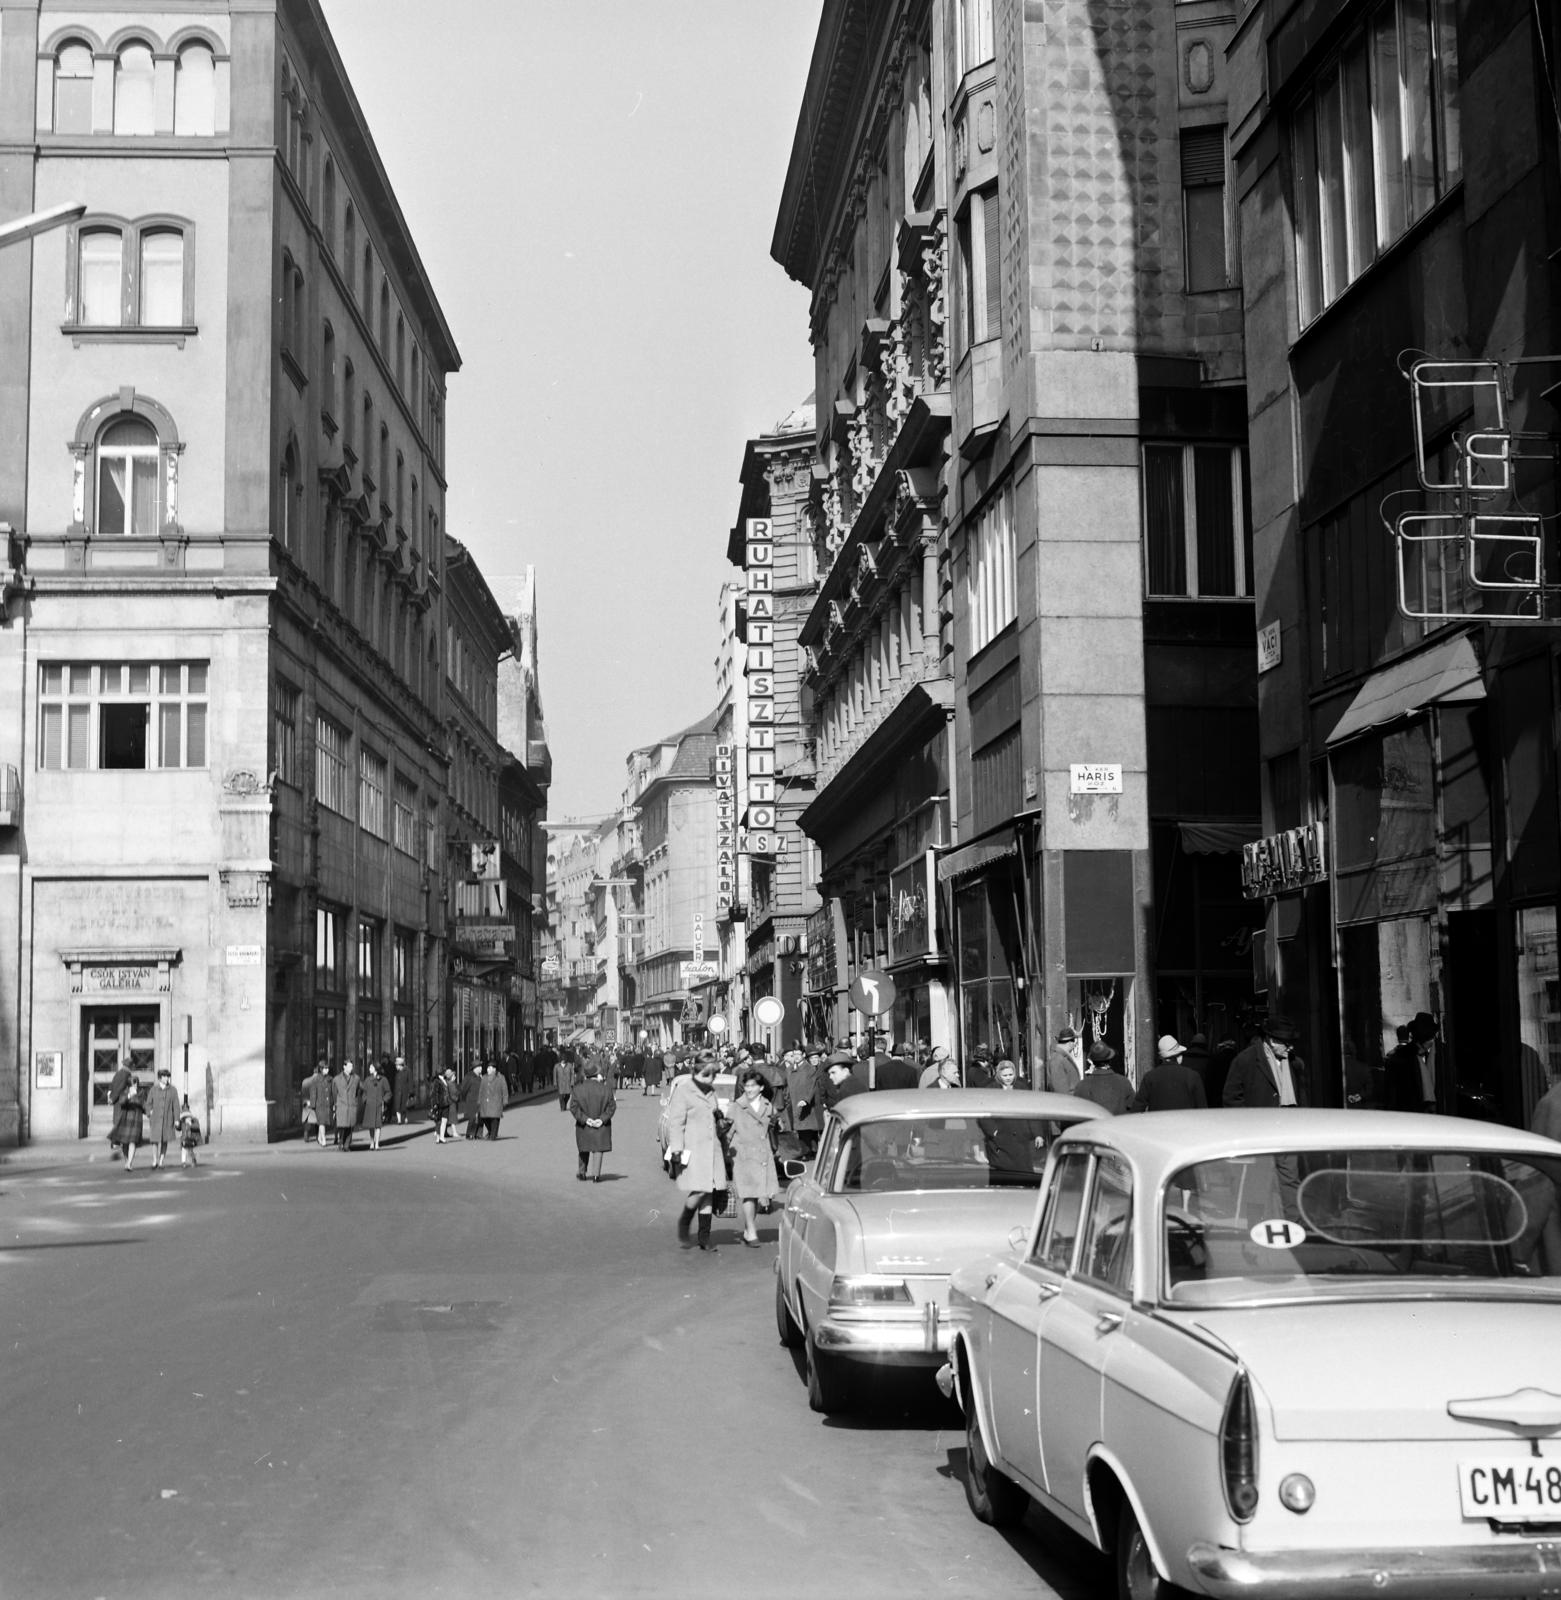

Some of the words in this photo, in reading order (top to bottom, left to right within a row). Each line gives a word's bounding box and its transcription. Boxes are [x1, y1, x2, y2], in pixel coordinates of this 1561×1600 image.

[1078, 772, 1114, 781] HARIS
[718, 746, 730, 906] DIVATSZALON
[1265, 1224, 1291, 1244] H
